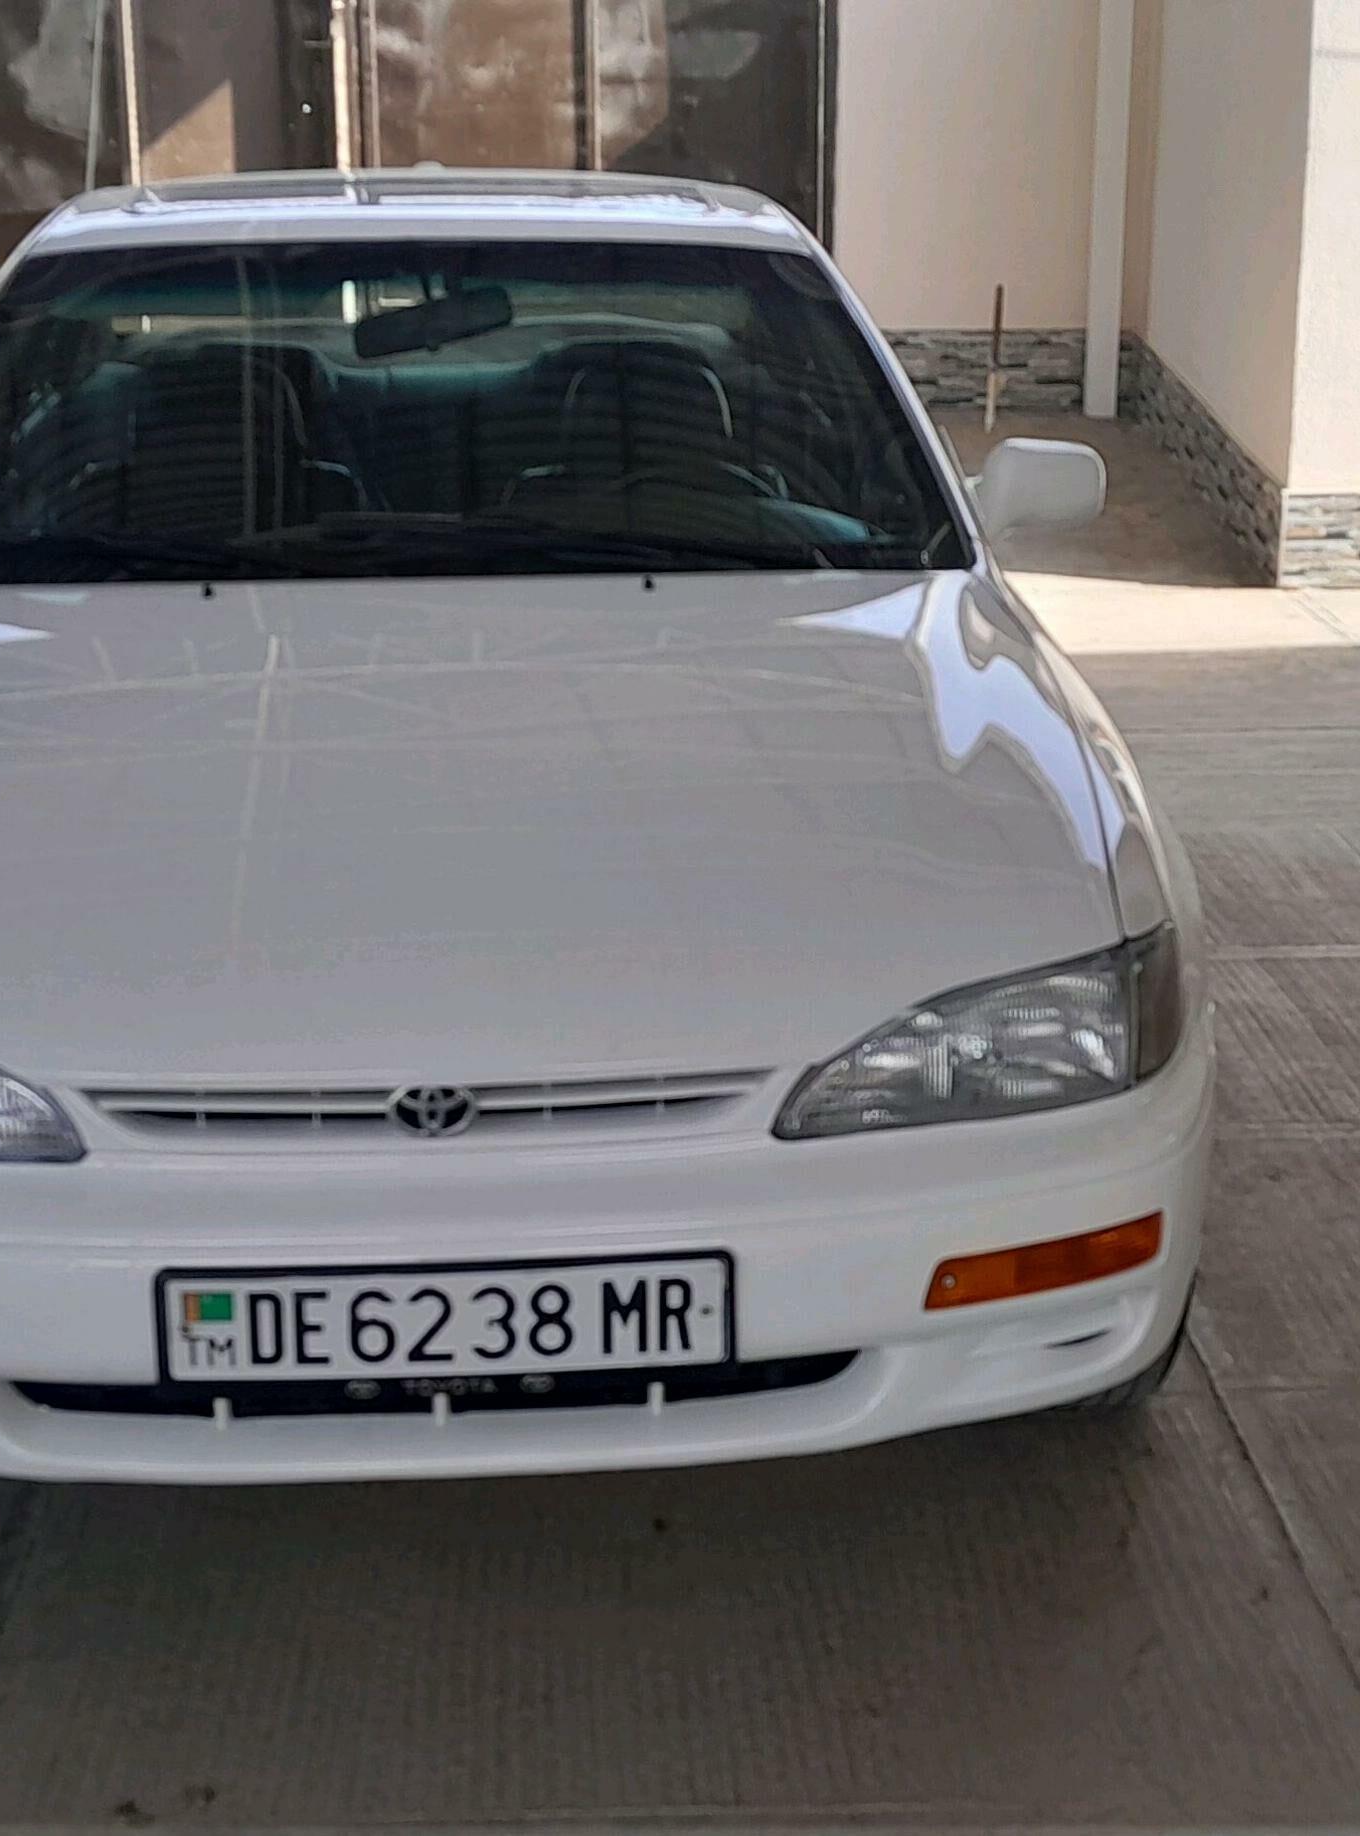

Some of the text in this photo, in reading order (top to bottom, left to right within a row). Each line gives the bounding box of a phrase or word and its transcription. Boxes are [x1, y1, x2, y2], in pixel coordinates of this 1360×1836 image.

[181, 1335, 237, 1367] TM
[248, 1278, 692, 1366] DE 6238 MR
